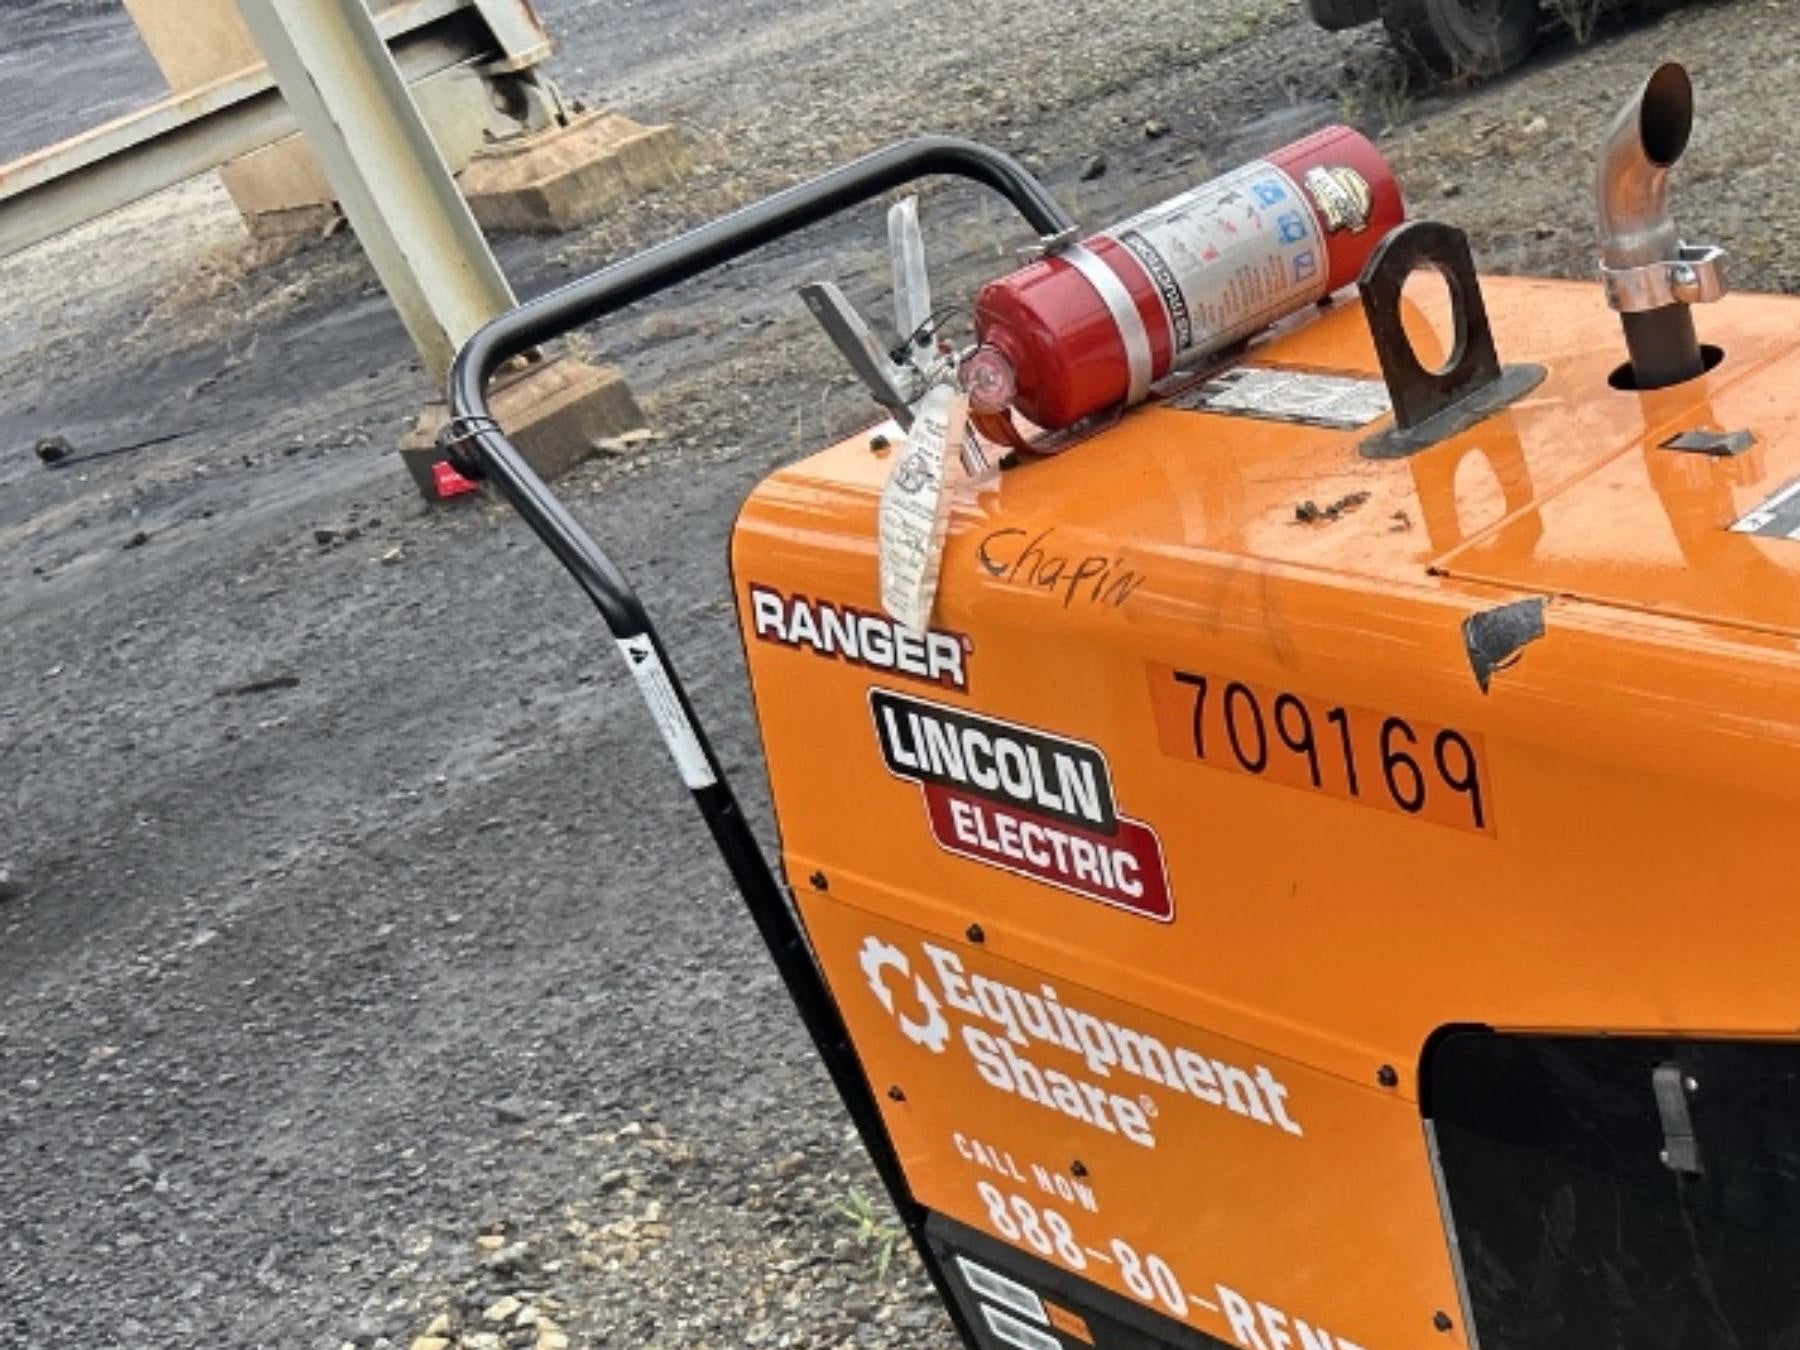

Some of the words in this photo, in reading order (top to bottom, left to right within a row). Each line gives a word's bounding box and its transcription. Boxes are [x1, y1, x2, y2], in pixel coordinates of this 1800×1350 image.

[977, 528, 1145, 606] Chapin
[881, 706, 1103, 822] LINCOLN
[1174, 671, 1485, 828] 709169
[951, 800, 1144, 898] ELECTRIC
[922, 942, 1303, 1137] Equipment
[953, 1132, 1026, 1182] CALL
[1032, 1164, 1098, 1213] NOW
